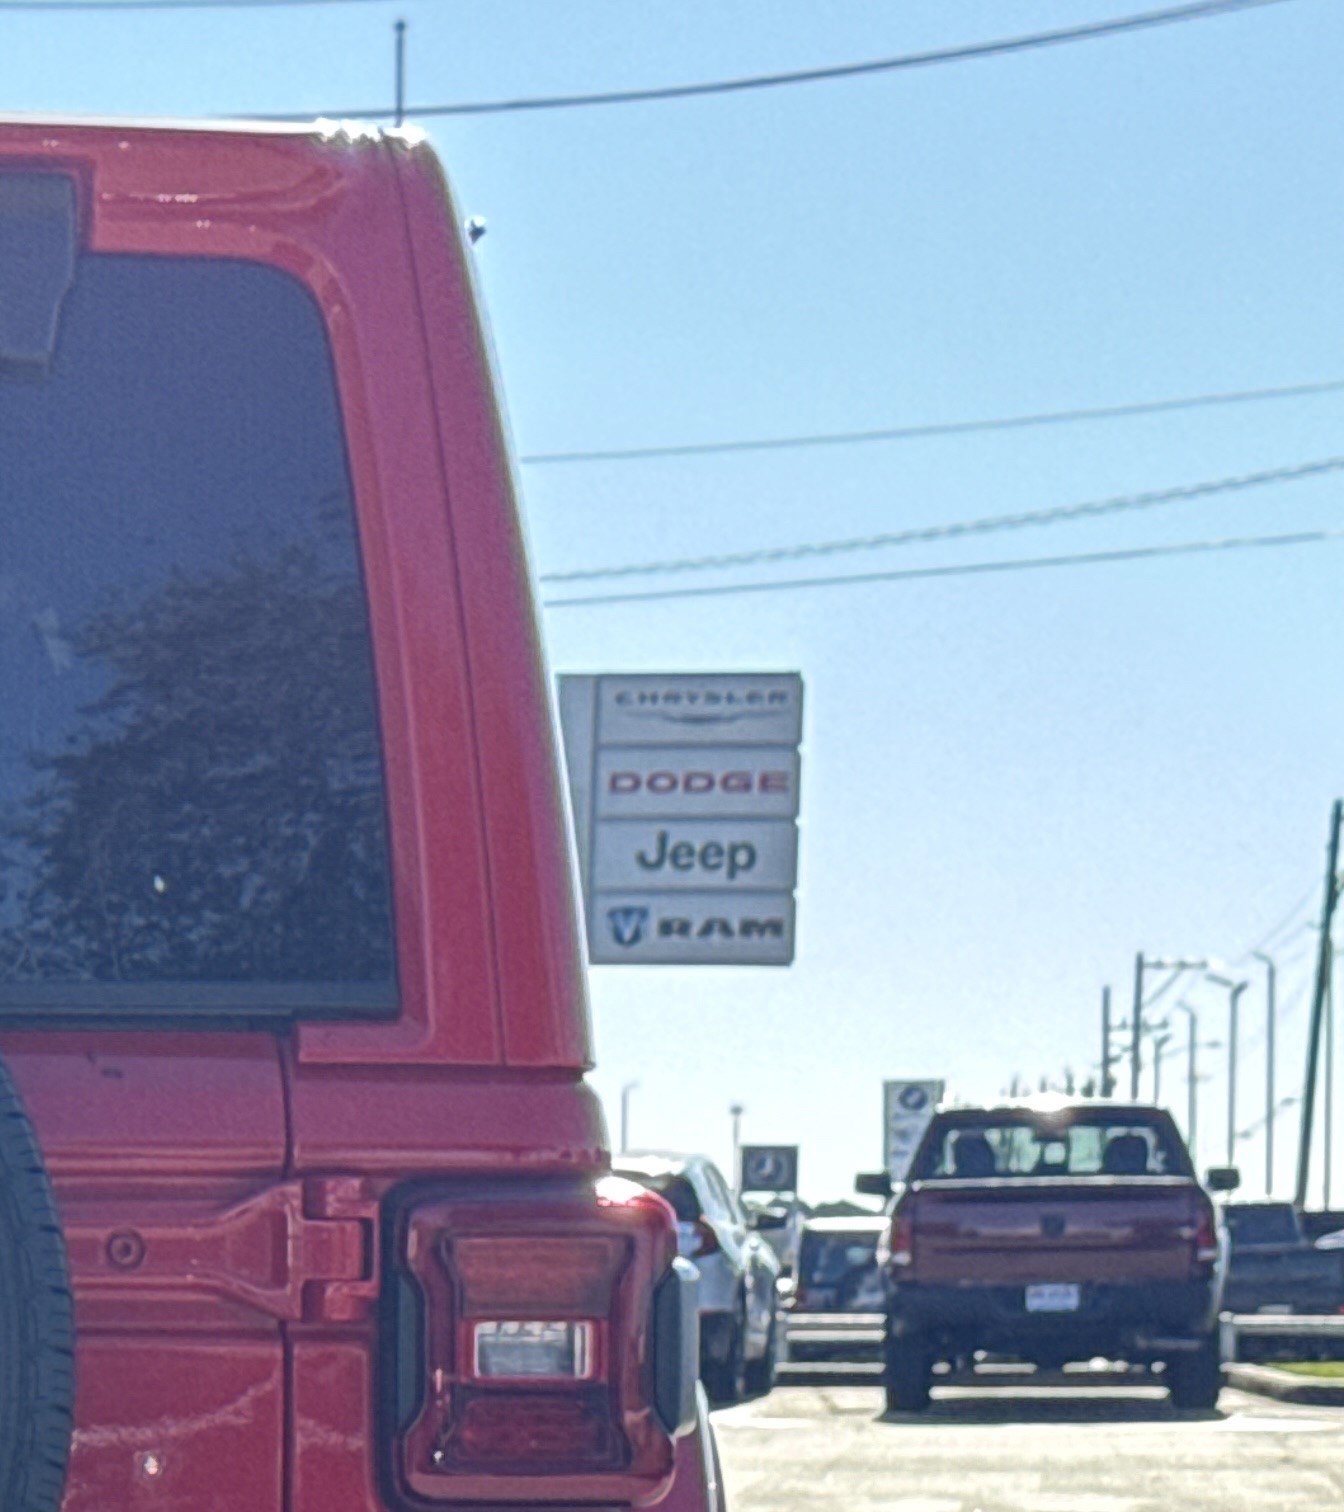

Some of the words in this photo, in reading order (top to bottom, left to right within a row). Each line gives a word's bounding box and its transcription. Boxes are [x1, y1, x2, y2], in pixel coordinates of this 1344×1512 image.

[609, 771, 789, 793] DODGE
[636, 829, 757, 880] Jeep
[658, 917, 783, 937] RAM
